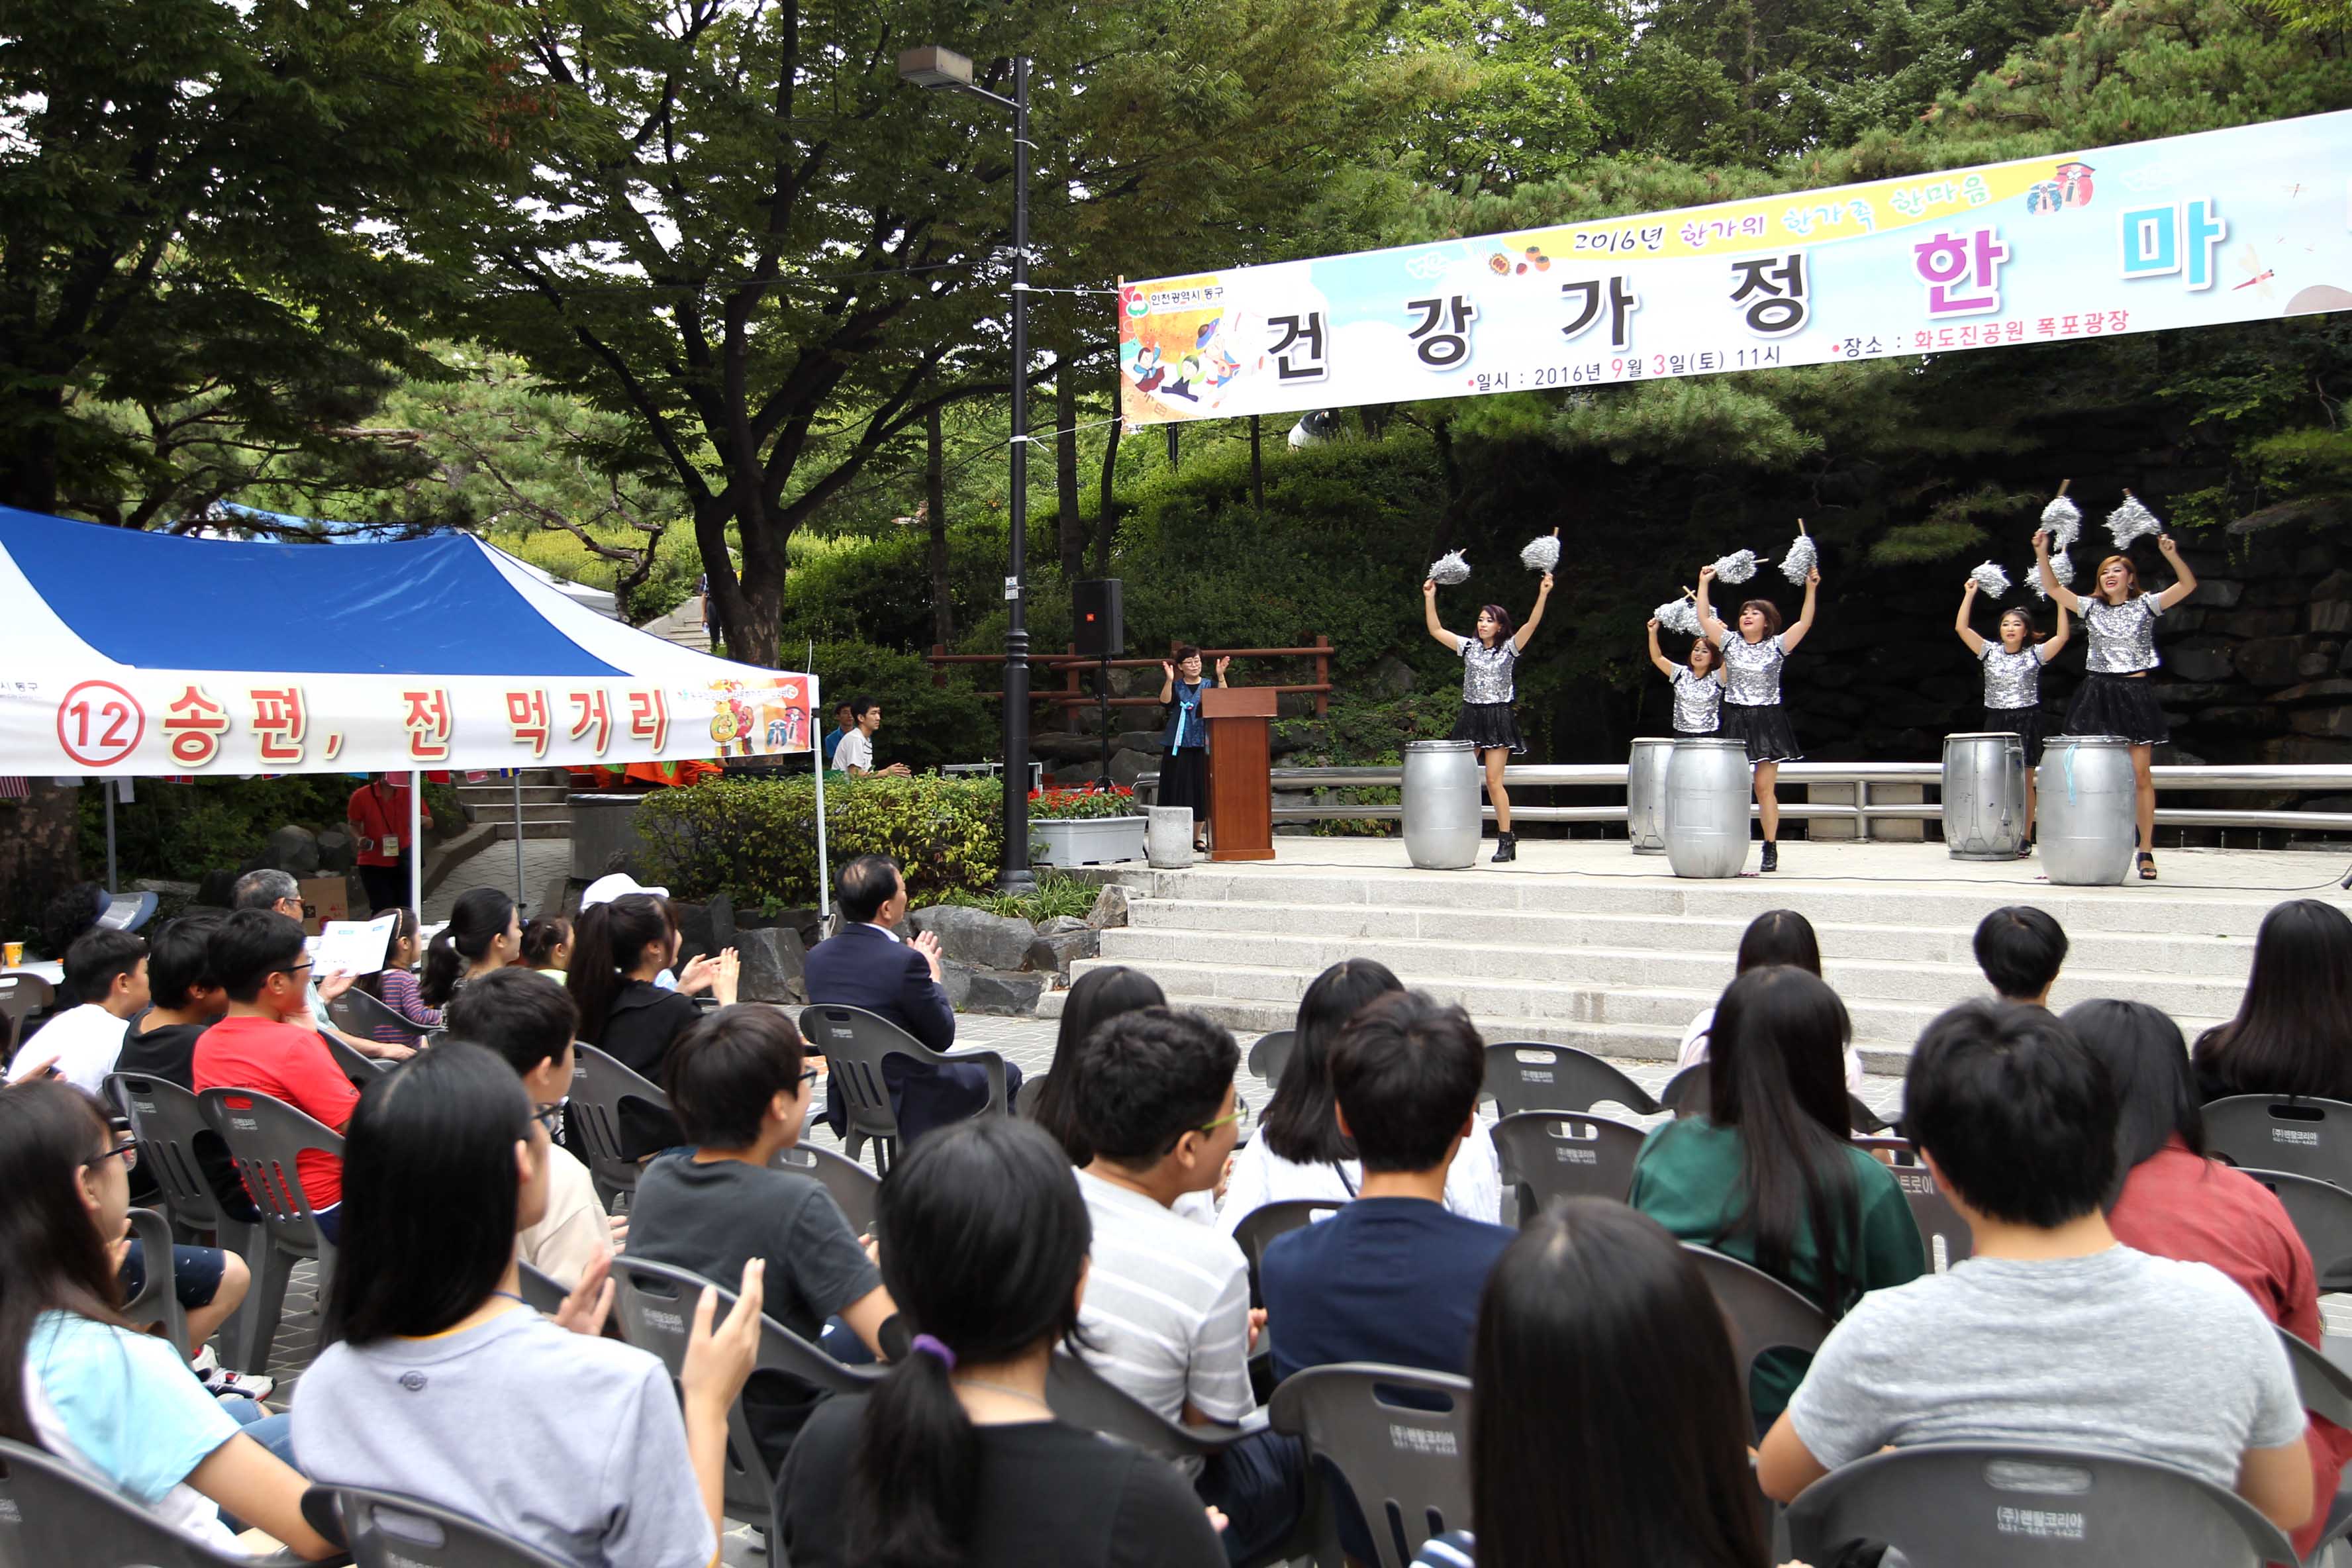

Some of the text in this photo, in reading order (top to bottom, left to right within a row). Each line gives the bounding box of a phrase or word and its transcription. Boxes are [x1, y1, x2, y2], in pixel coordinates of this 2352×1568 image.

[1575, 174, 1990, 251] 2016년 한가위 한가족 한마음
[1151, 287, 1224, 305] 인천광역시 동구
[1914, 320, 2024, 351] 화도진공원
[2037, 309, 2130, 339] 폭포광장
[1535, 364, 1601, 386] 2016년
[1611, 358, 1642, 380] 9월
[1653, 350, 1724, 376] 3일(토)
[1737, 345, 1781, 368] 11시
[402, 687, 450, 757] 전
[505, 688, 666, 756] 먹거리
